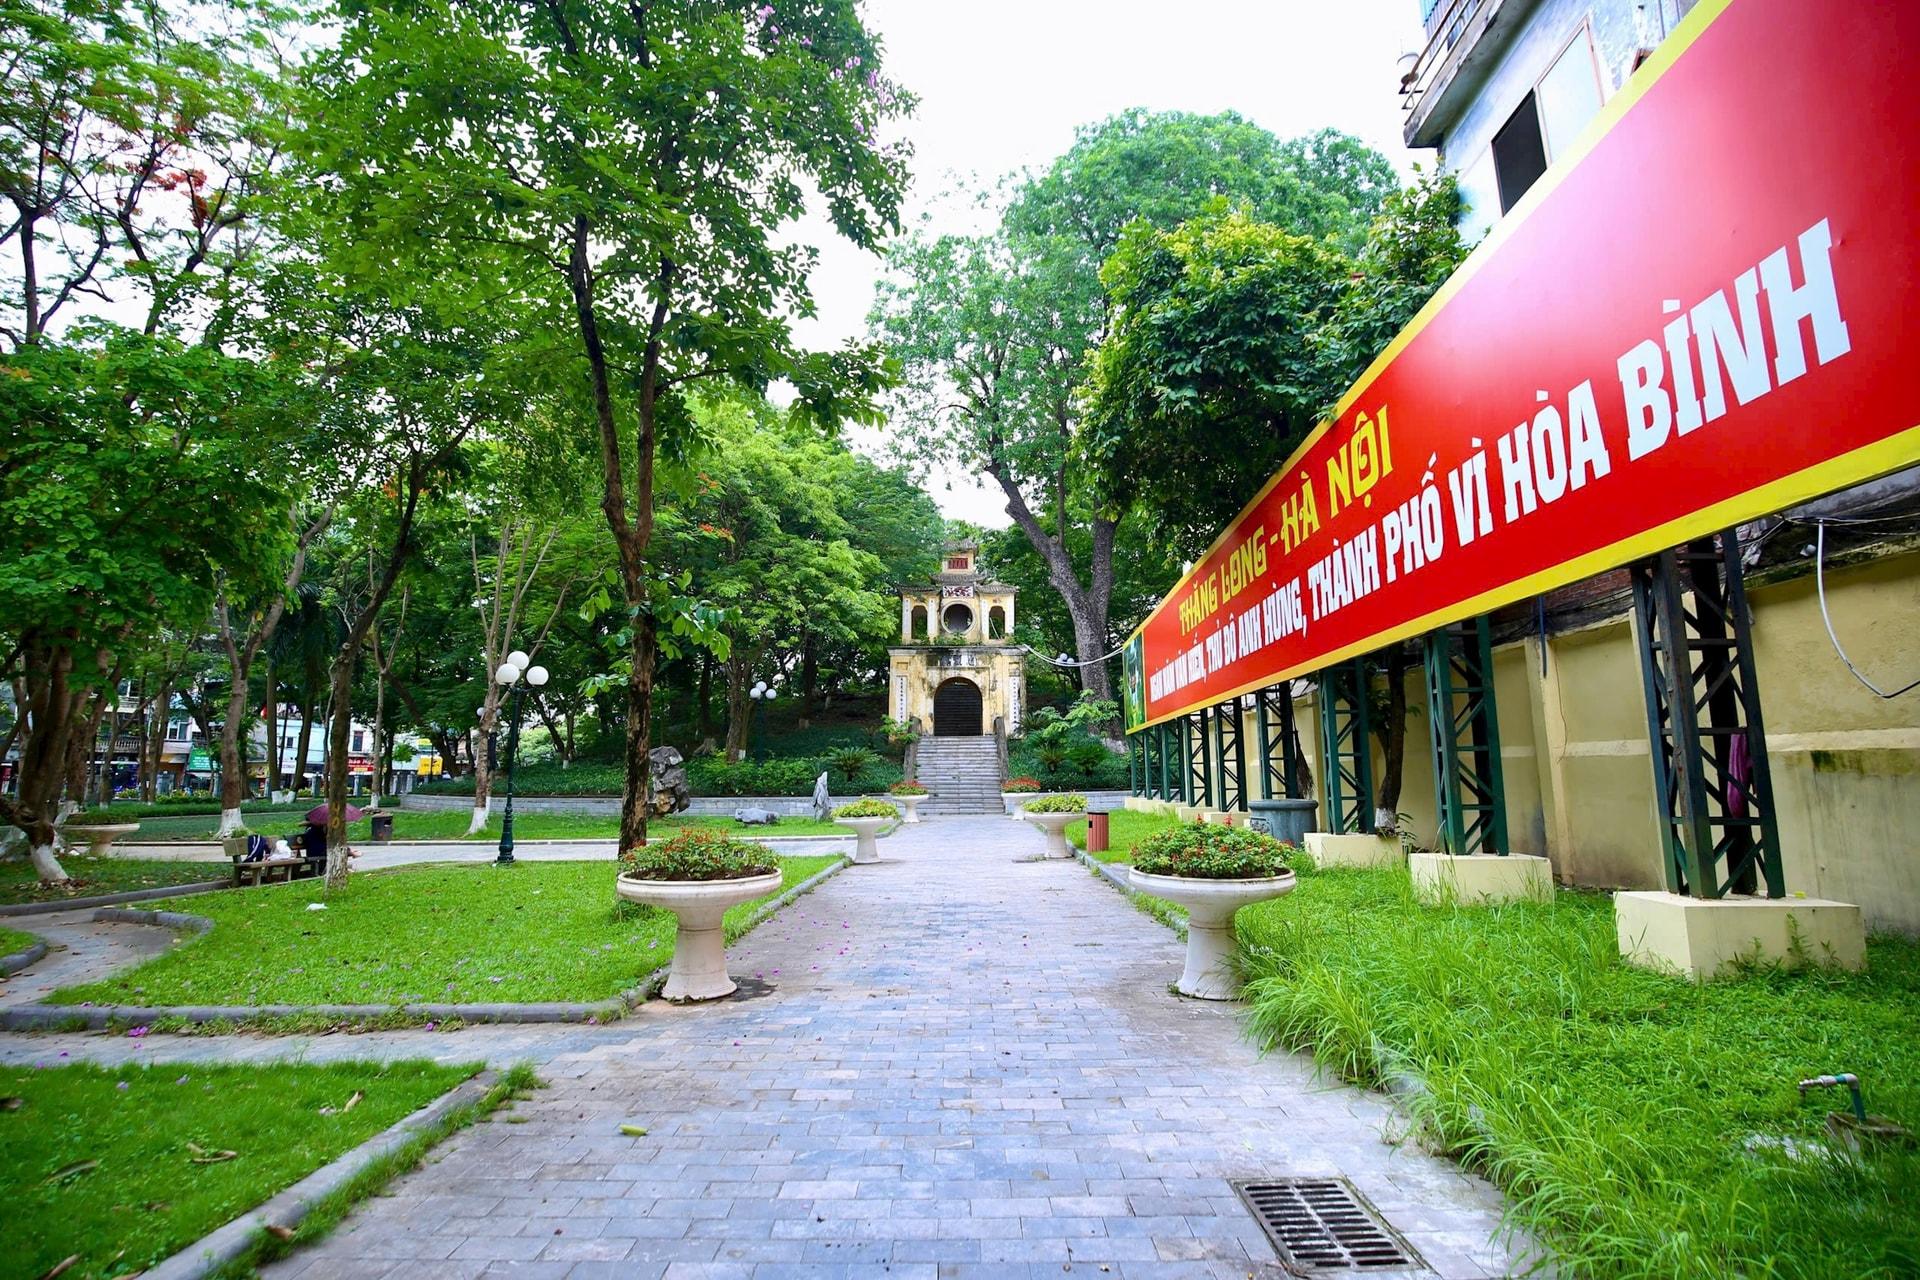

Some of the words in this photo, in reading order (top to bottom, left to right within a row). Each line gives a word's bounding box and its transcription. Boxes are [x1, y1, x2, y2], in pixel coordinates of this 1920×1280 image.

[1178, 572, 1218, 636] THĂNG
[1220, 525, 1267, 604] LONG
[1326, 403, 1393, 519] NỘI
[1238, 603, 1262, 659] ANH
[1262, 576, 1307, 639] HÙNG,
[1307, 524, 1381, 622] THÀNH
[1382, 451, 1444, 584] PHỐ
[1447, 437, 1494, 547] VÌ
[1497, 378, 1611, 525] HÒA
[1616, 217, 1851, 462] BÌNH
